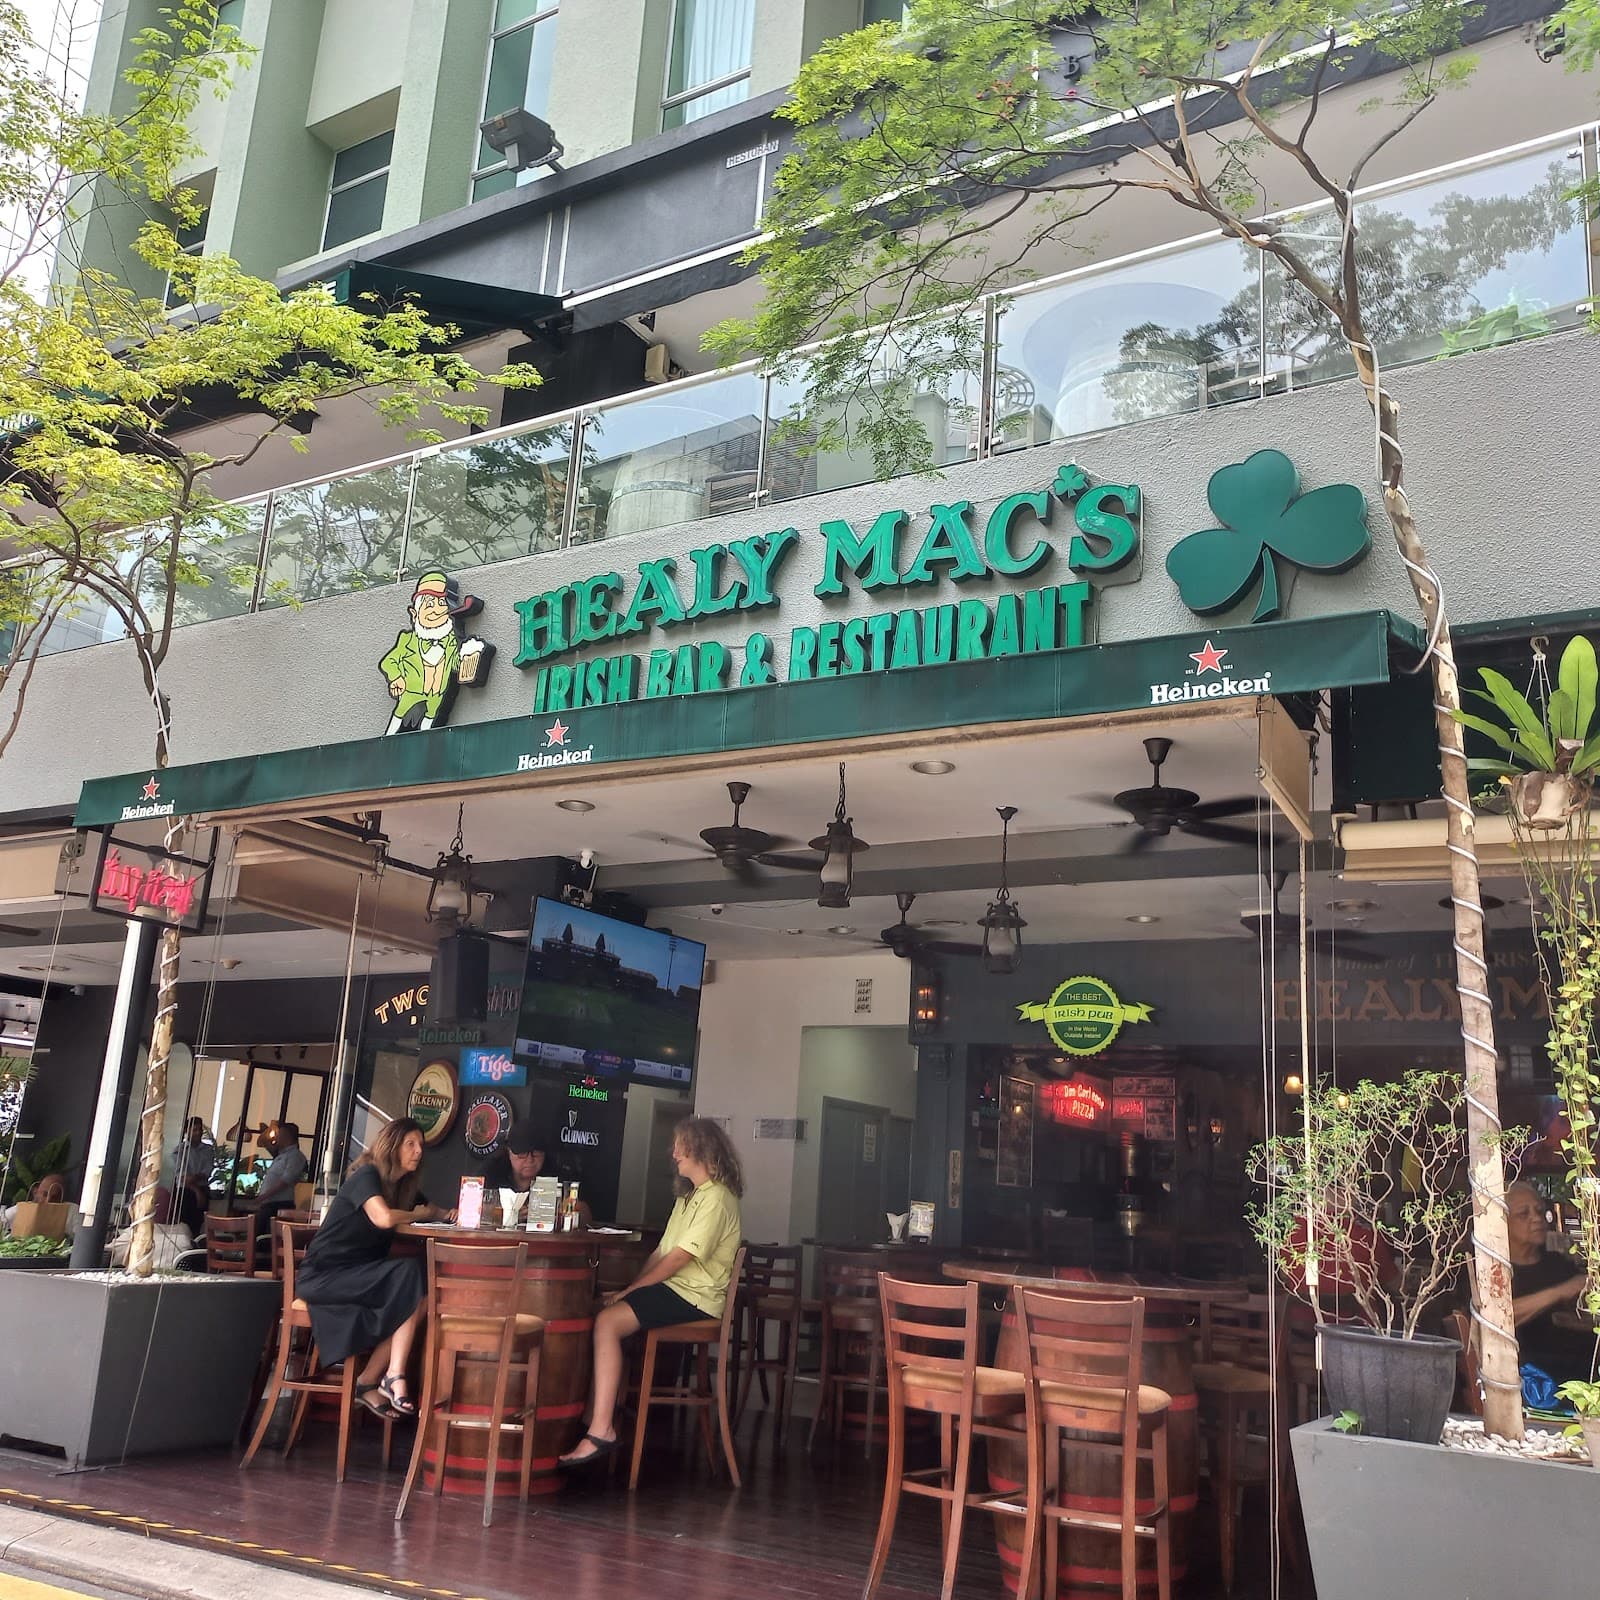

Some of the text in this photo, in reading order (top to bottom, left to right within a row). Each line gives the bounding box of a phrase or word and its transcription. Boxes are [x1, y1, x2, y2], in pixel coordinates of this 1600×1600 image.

[513, 466, 1141, 668] HEALY MAC'S
[533, 581, 1093, 713] IRISH BAR & RESTAURANT
[1150, 673, 1271, 704] Heineken
[517, 745, 593, 771] Heineken
[120, 800, 174, 820] Heineken
[1065, 993, 1102, 1001] THE BEST
[410, 1093, 449, 1109] KILKENNY
[568, 1084, 609, 1101] Heineken
[1072, 1099, 1095, 1120] PIZZA
[560, 1127, 599, 1146] GUINNESS
